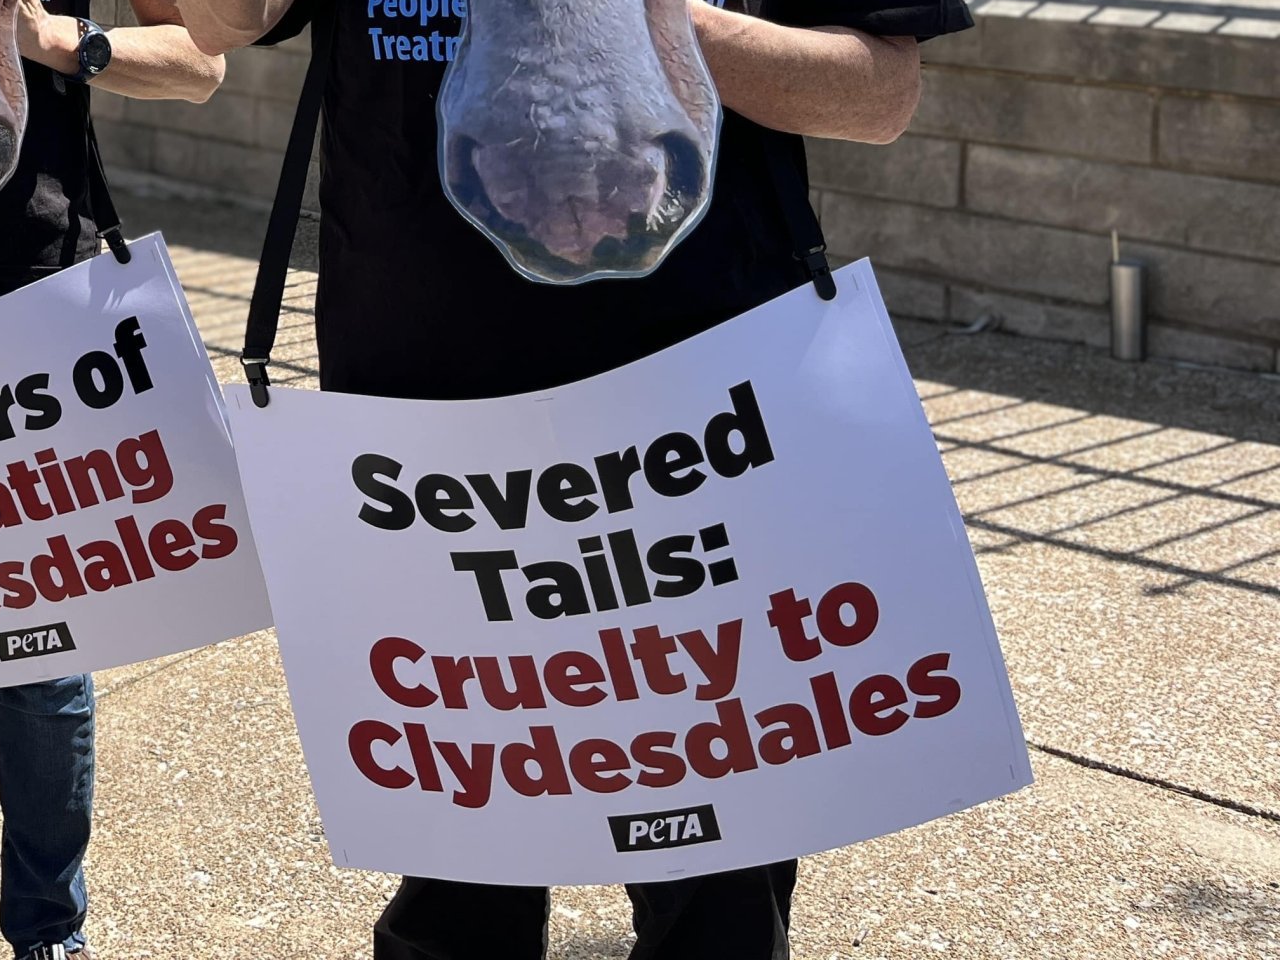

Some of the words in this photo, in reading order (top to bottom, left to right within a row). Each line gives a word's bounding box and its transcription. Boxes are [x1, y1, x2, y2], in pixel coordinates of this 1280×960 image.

[72, 315, 155, 410] of
[351, 379, 776, 533] Severed
[449, 521, 740, 622] Tails:
[369, 618, 744, 711] Cruelty
[767, 581, 879, 662] to
[347, 652, 962, 809] Clydesdales
